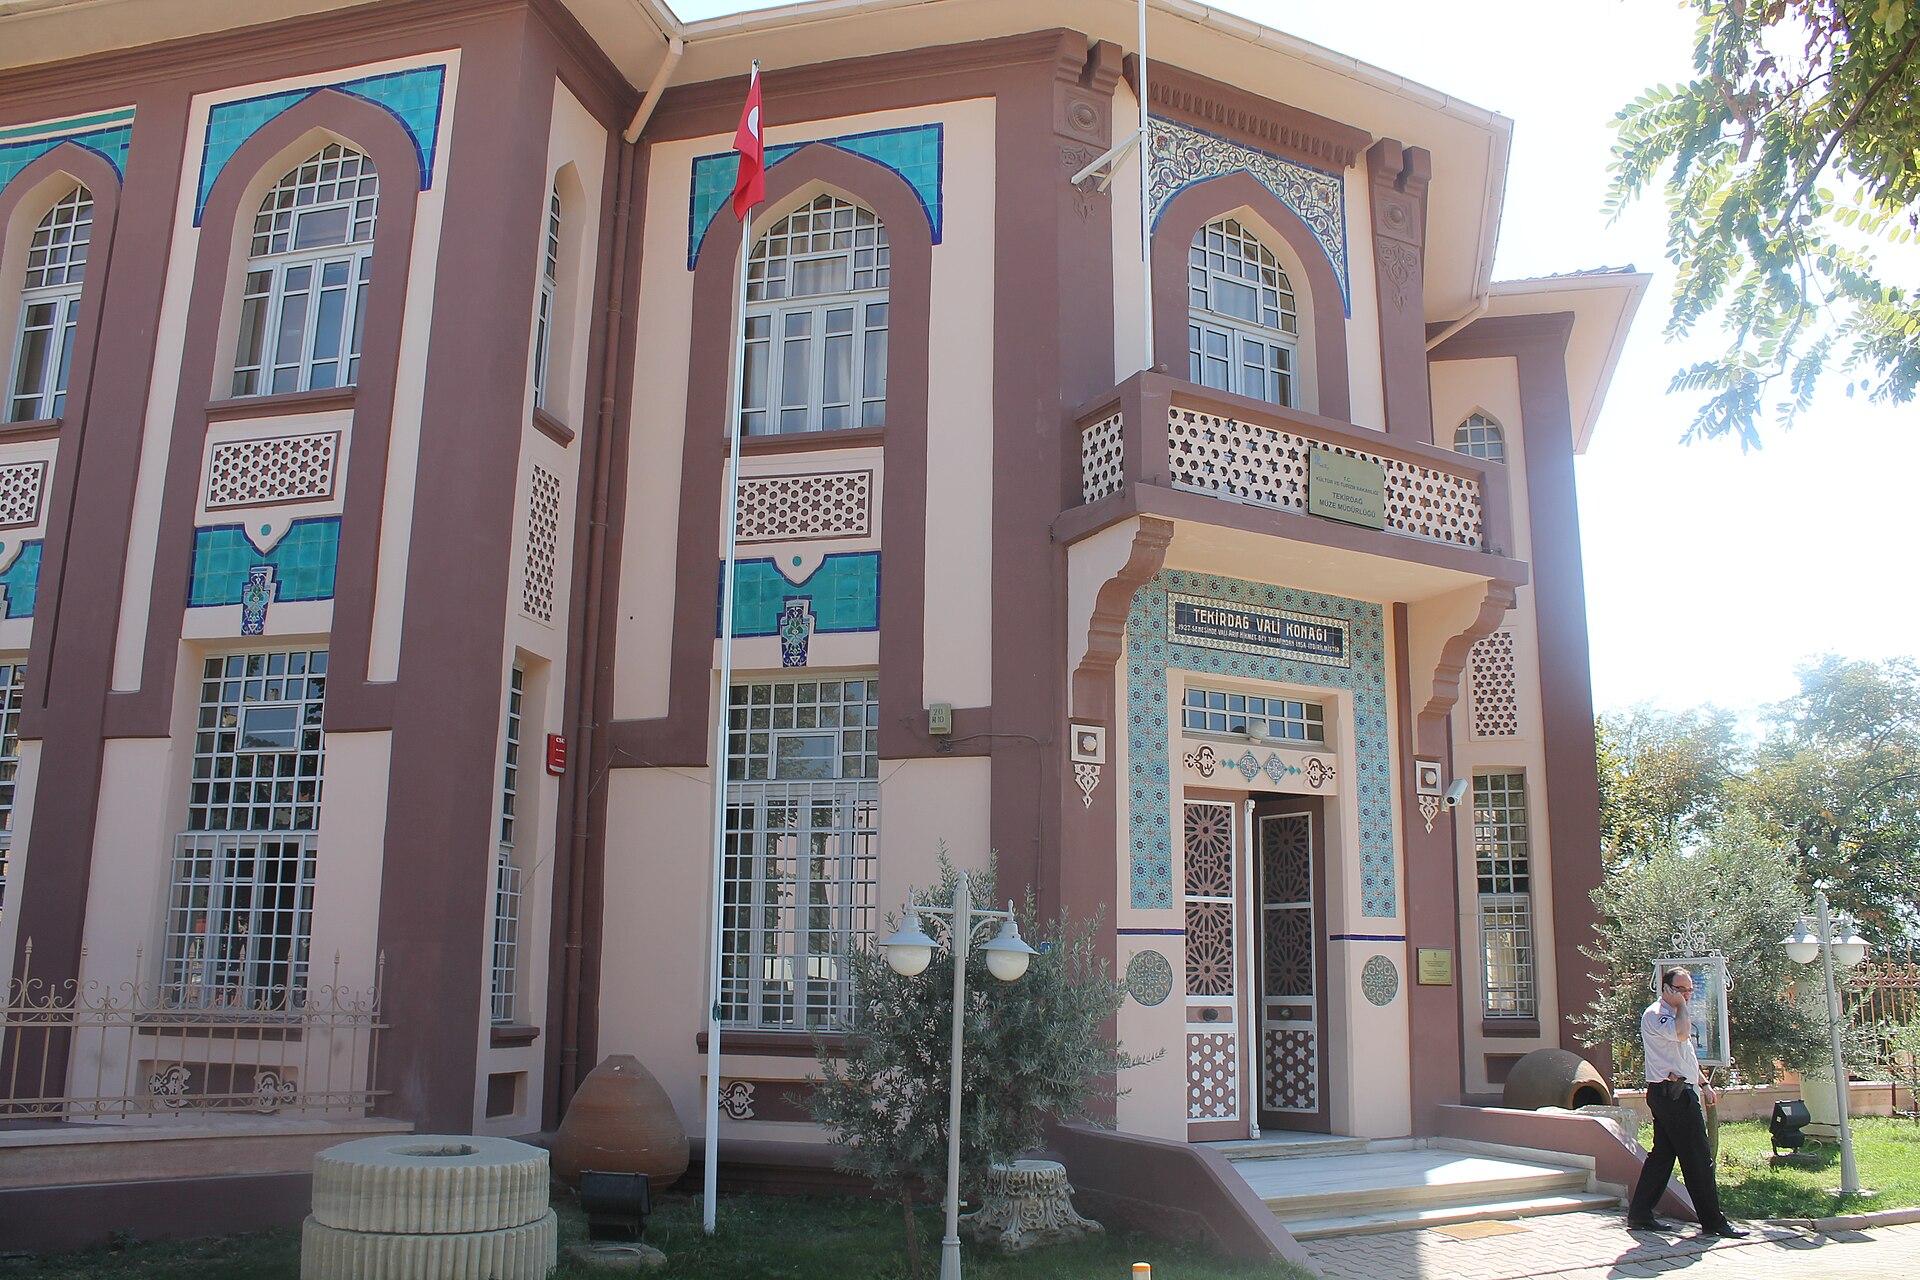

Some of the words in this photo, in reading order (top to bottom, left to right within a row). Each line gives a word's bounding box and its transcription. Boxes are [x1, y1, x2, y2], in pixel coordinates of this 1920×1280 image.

[1319, 498, 1337, 509] MÜZE
[1337, 503, 1376, 518] MÜDÜRLÜĞÜ
[1193, 608, 1250, 630] TEKİRDAĞ
[1256, 617, 1281, 635] VALİ
[1286, 622, 1328, 643] KONAĞI
